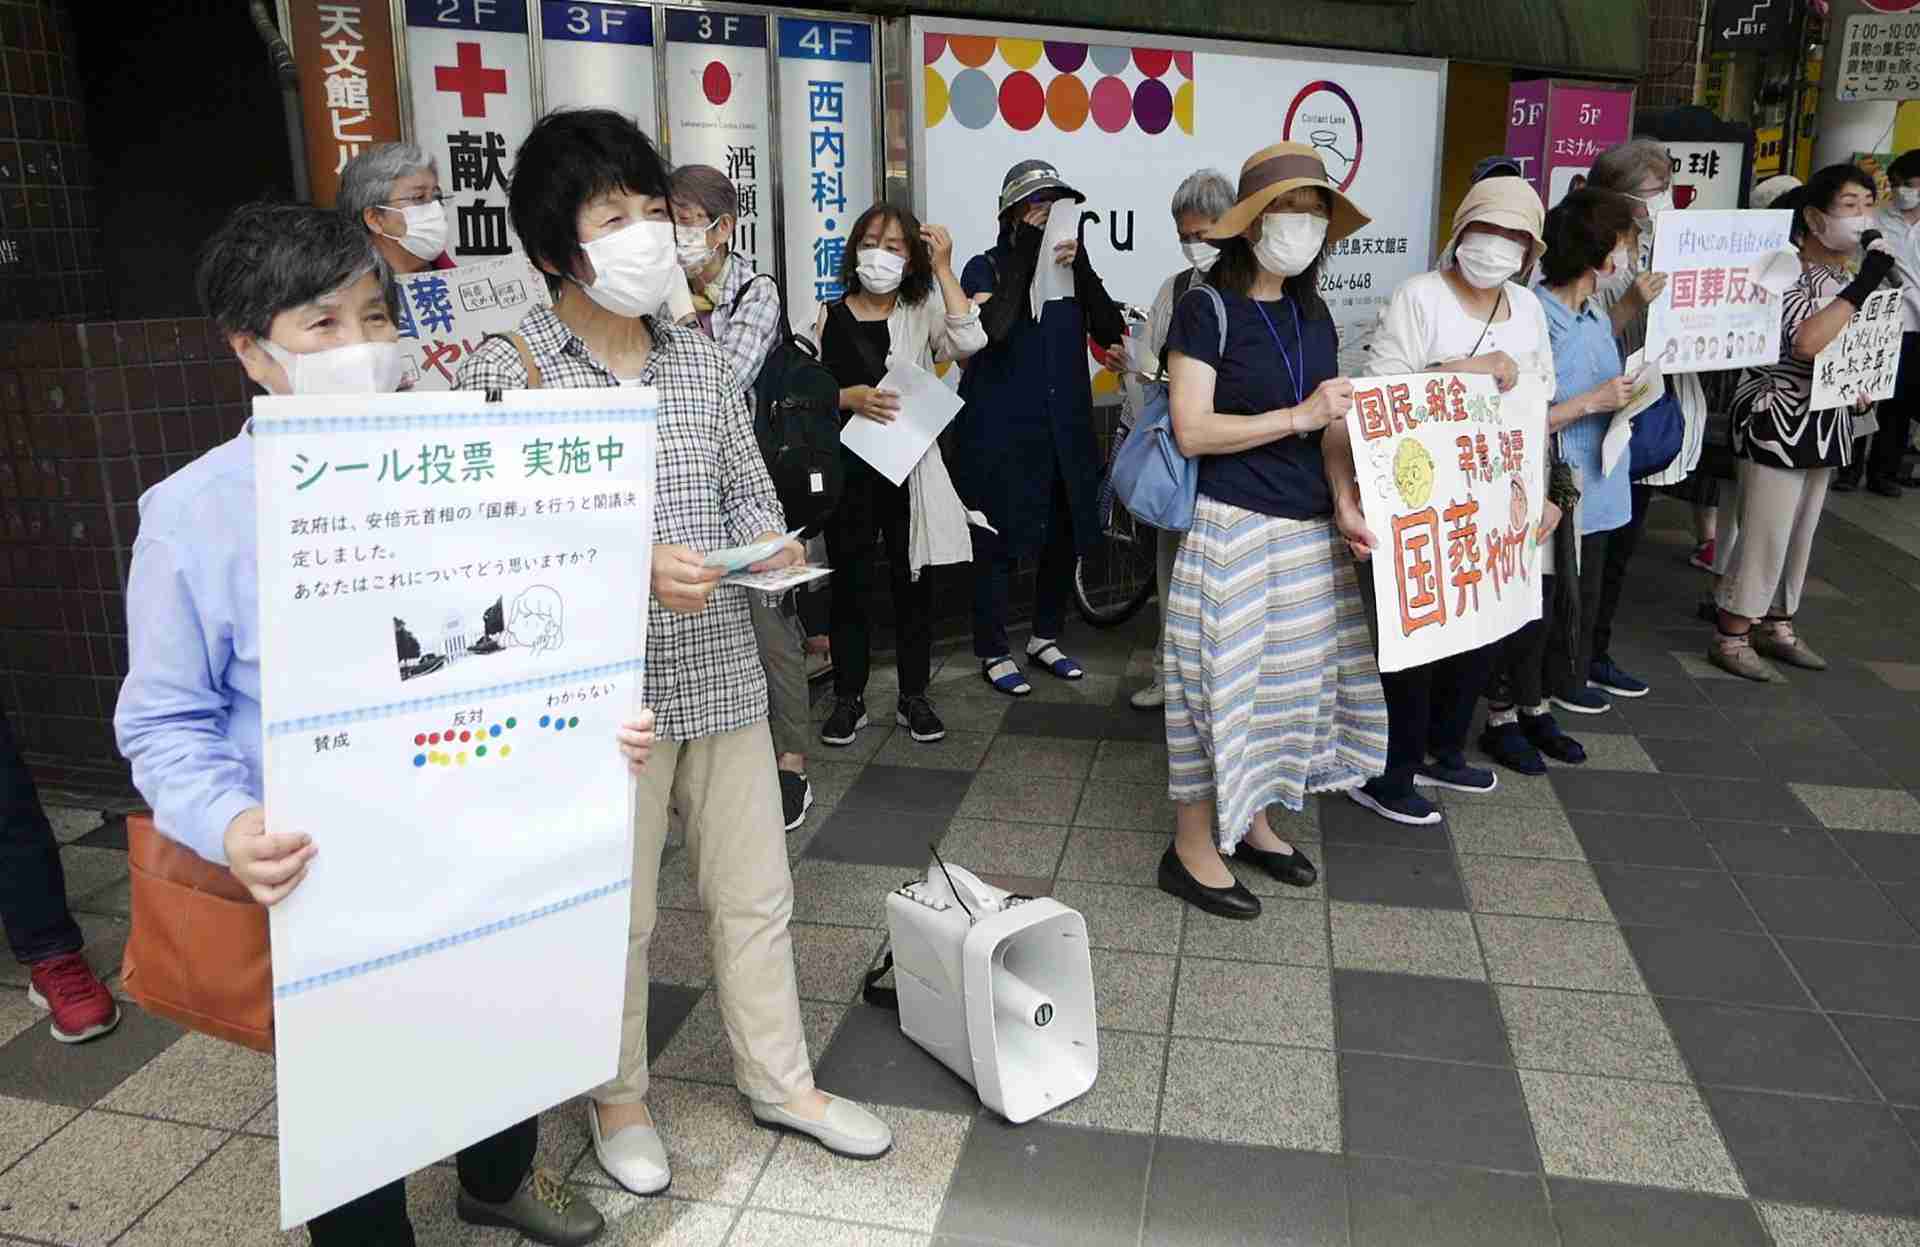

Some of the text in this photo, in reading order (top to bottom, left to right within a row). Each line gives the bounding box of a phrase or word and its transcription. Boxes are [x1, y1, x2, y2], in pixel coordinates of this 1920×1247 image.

[436, 0, 497, 24] 2F
[566, 6, 626, 35] 3F
[697, 15, 739, 40] 3F
[799, 26, 853, 56] 4F
[1845, 75, 1920, 92] ここから
[1511, 100, 1543, 126] 5F
[1579, 103, 1602, 125] 5F
[447, 130, 513, 256] 献血
[290, 435, 624, 491] シール投票 実施中
[291, 543, 398, 569] 定しました。
[545, 683, 615, 708] わからない
[452, 708, 483, 726] 反対
[314, 734, 351, 753] 賛成
